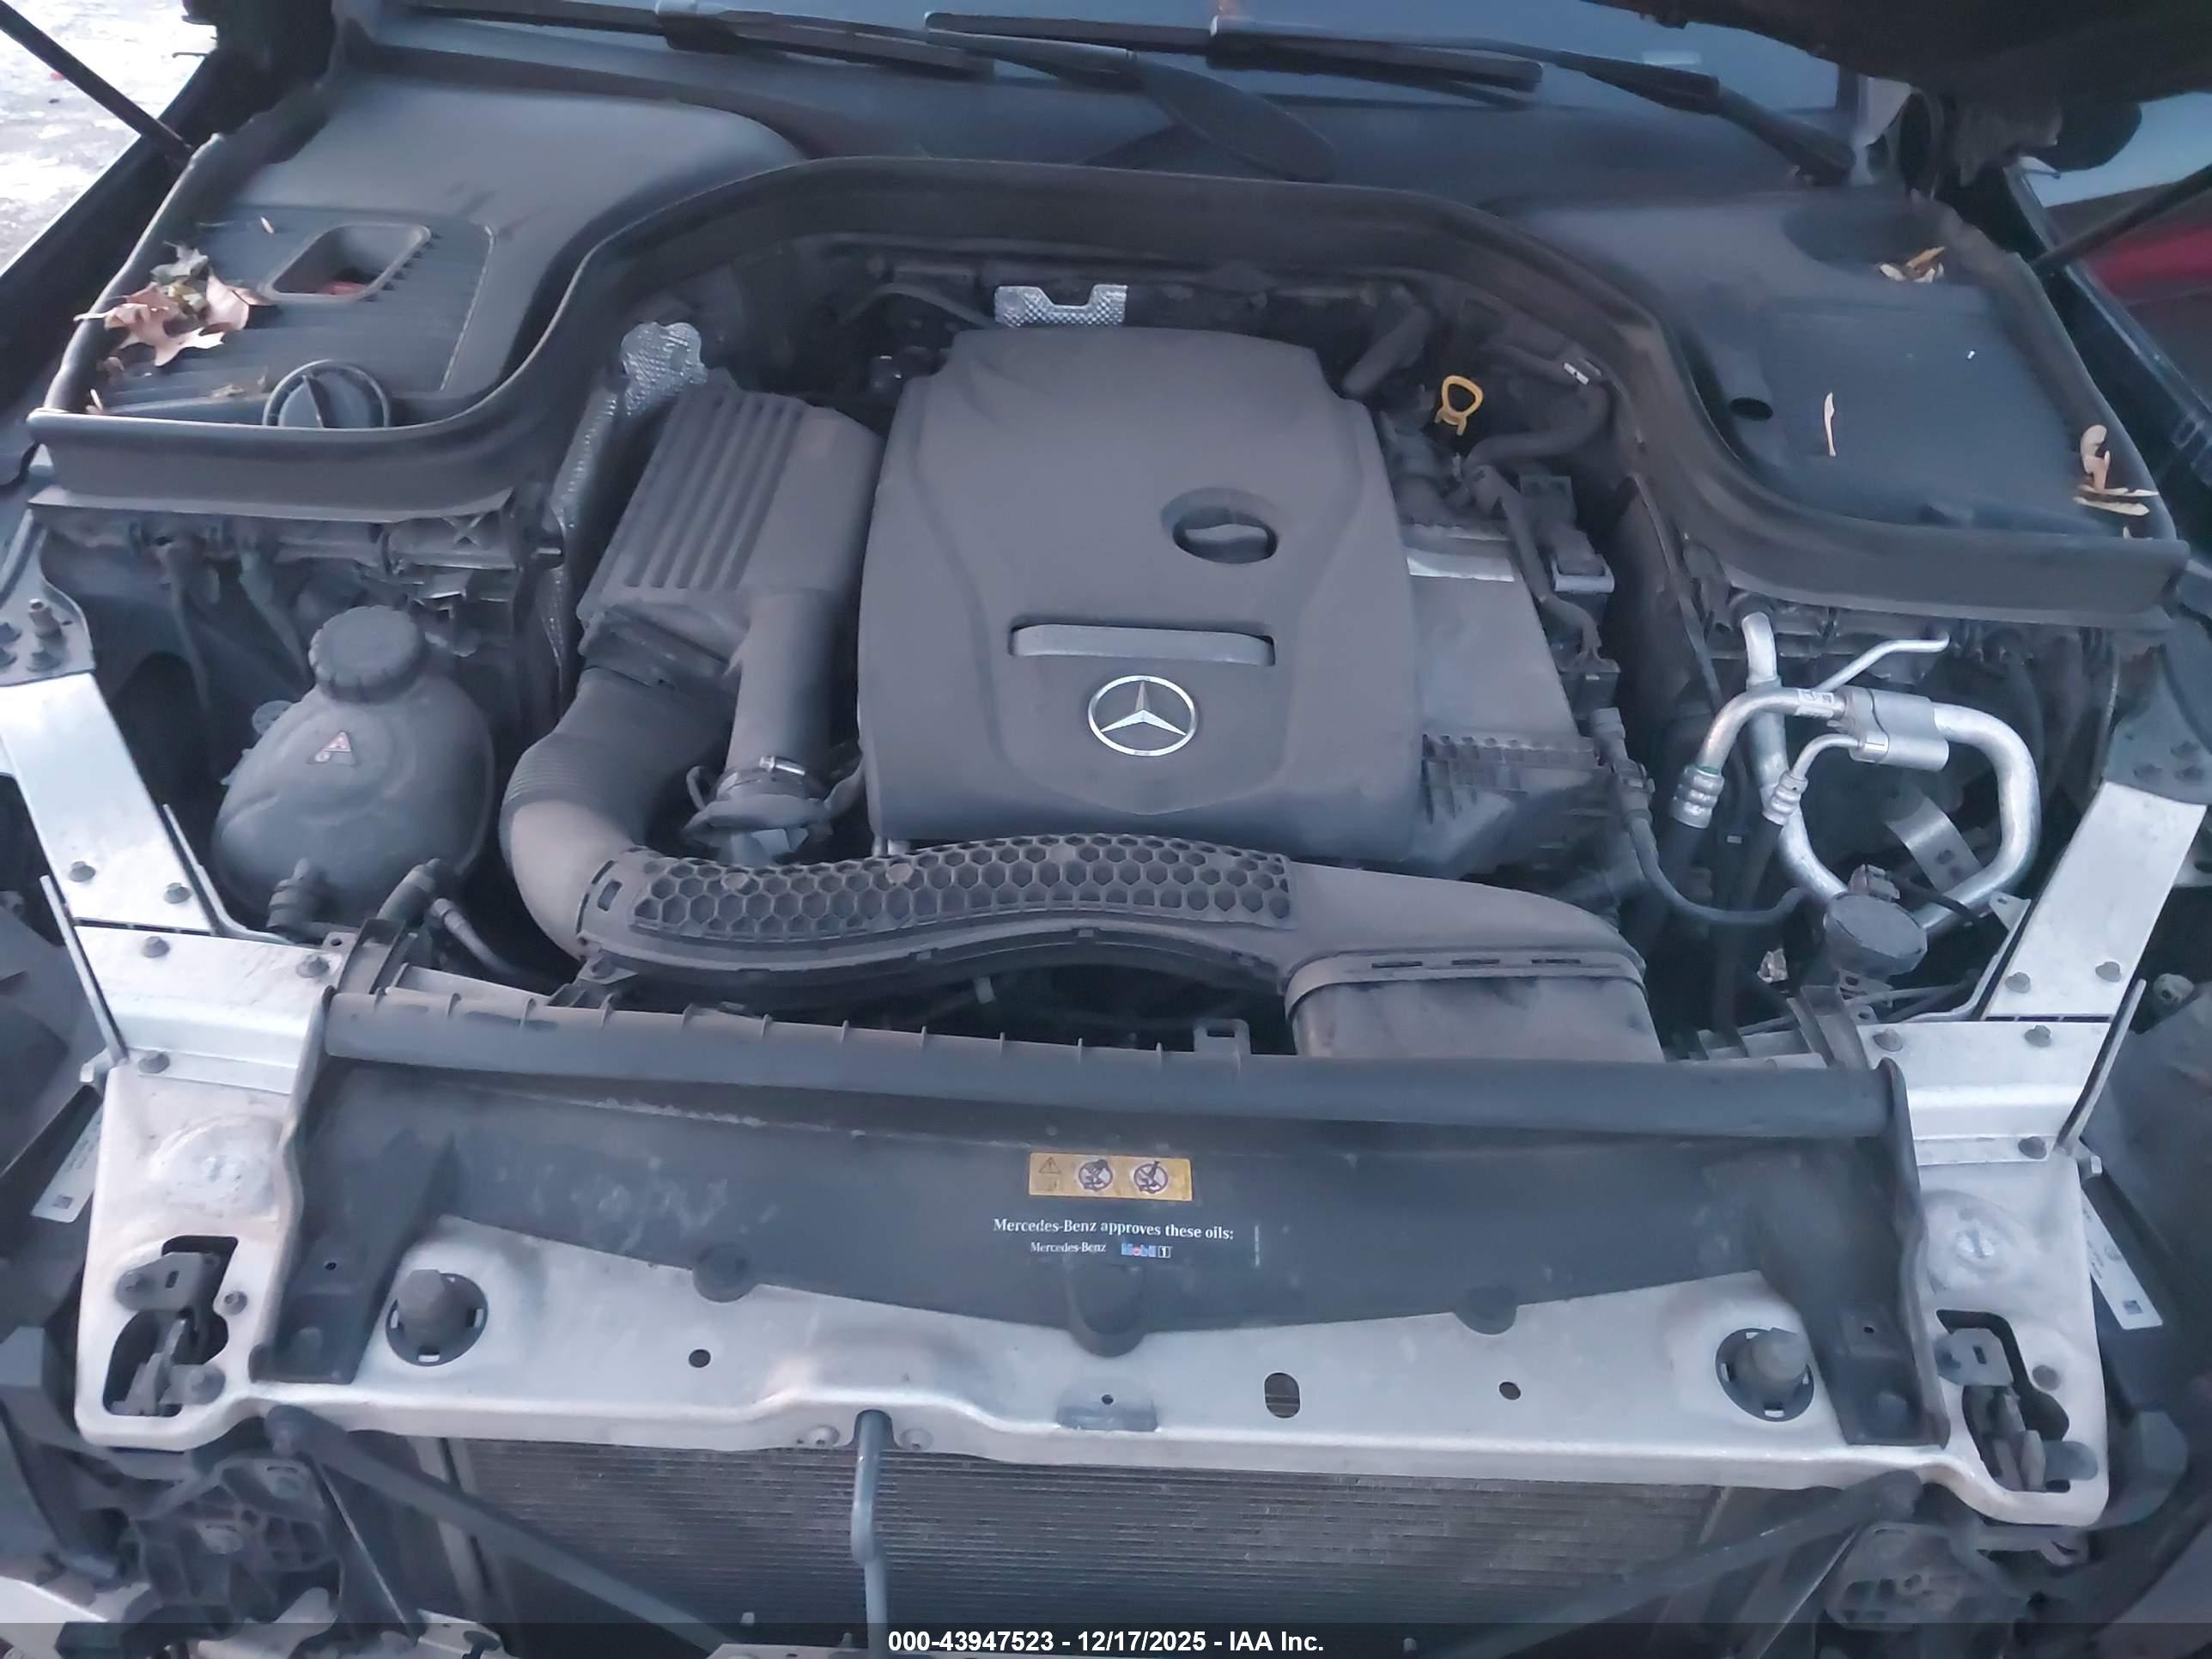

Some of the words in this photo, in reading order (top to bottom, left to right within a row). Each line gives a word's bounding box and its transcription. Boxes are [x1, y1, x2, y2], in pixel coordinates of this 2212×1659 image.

[994, 1218, 1097, 1232] Mercedes-Benz
[1100, 1222, 1161, 1236] approves
[1164, 1224, 1202, 1238] these
[1205, 1225, 1234, 1240] oils:
[1030, 1241, 1107, 1253] Mercedes-Benz
